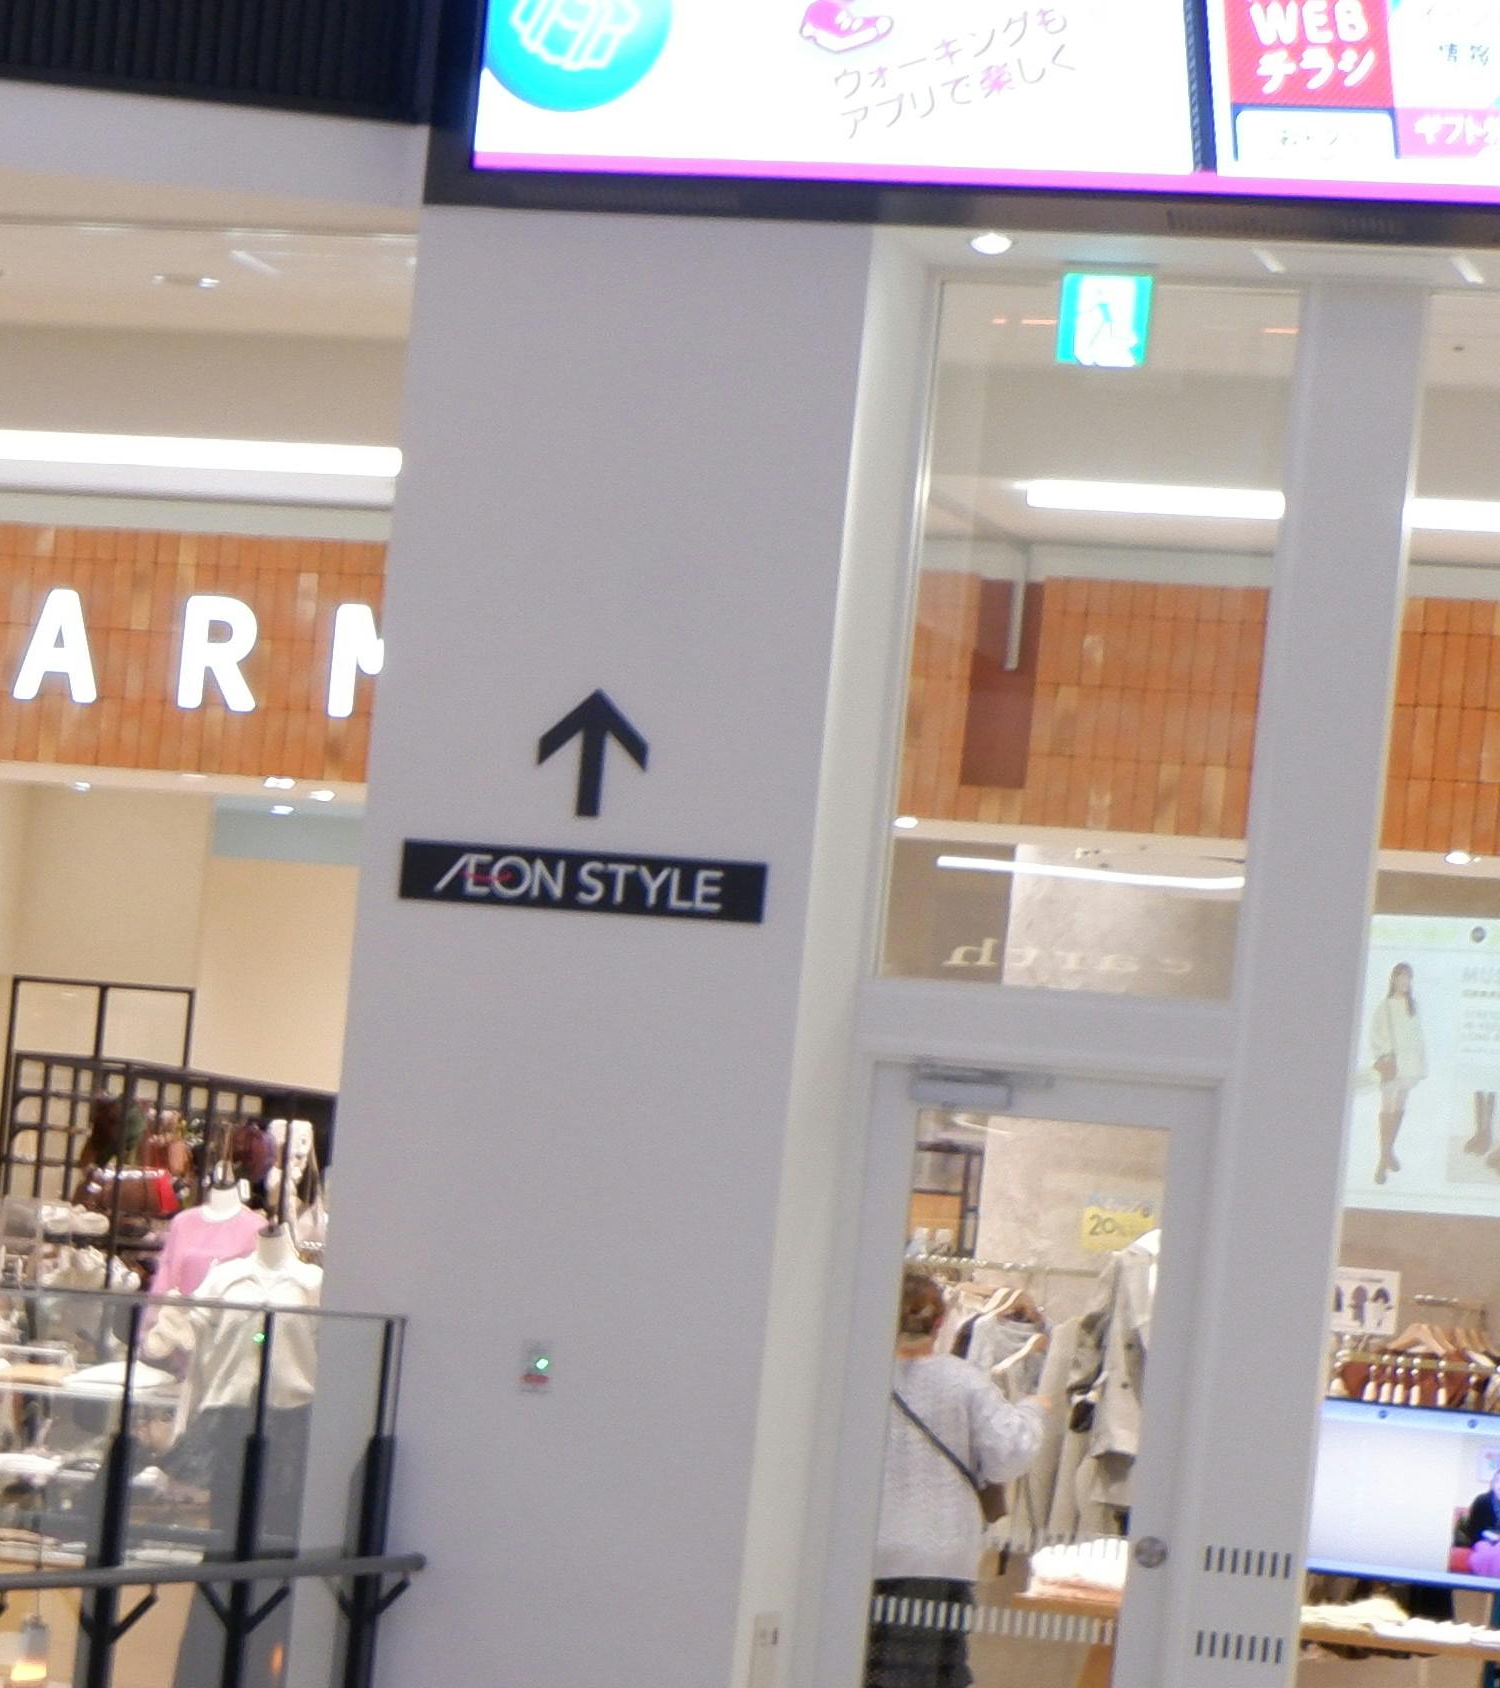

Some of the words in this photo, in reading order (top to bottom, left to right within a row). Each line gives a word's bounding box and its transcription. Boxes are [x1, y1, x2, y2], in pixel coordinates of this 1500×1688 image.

[1250, 0, 1369, 45] WEB
[1256, 46, 1376, 95] チラシ
[574, 861, 724, 913] STYLE
